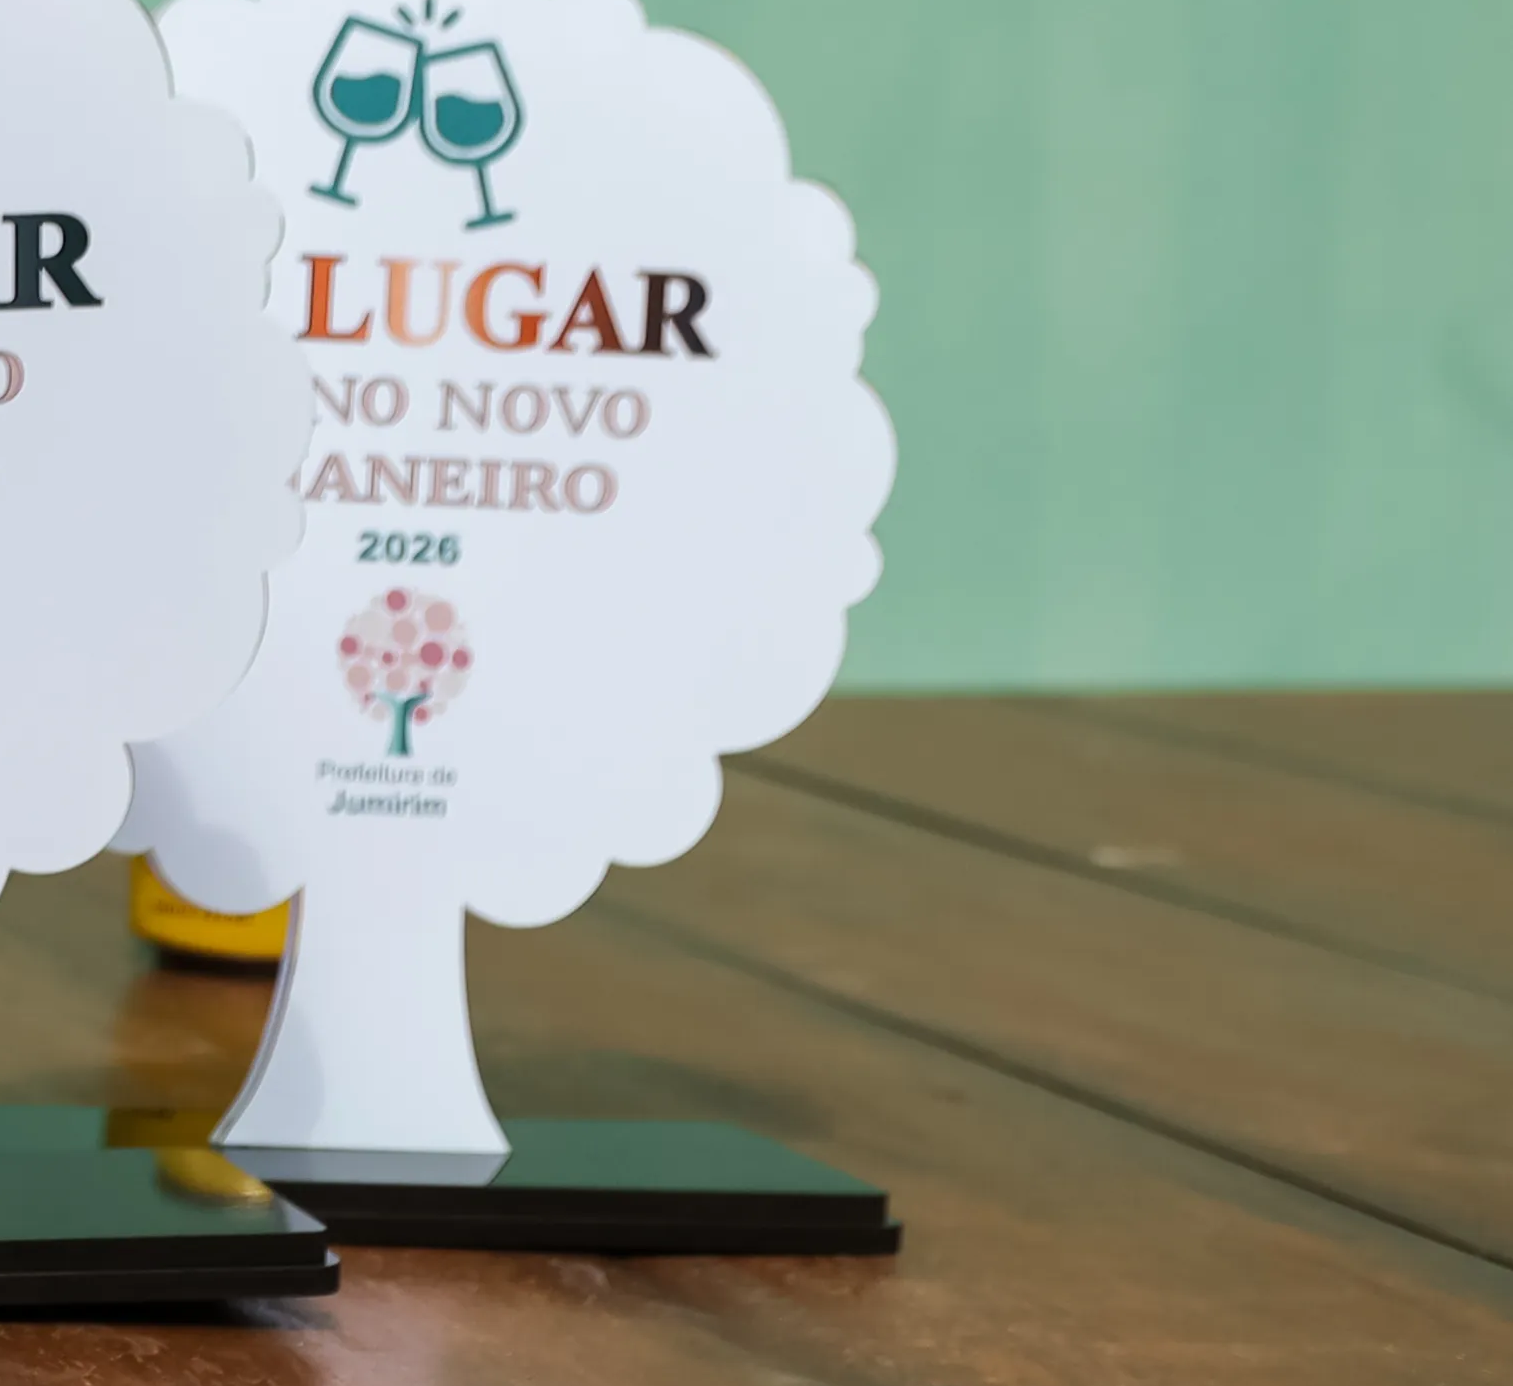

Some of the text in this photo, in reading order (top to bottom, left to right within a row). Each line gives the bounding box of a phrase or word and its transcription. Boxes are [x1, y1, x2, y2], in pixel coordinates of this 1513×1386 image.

[296, 253, 715, 359] LUGAR
[312, 374, 650, 438] NO NOVO
[285, 452, 618, 514] ANEIRO
[357, 531, 461, 564] 2026
